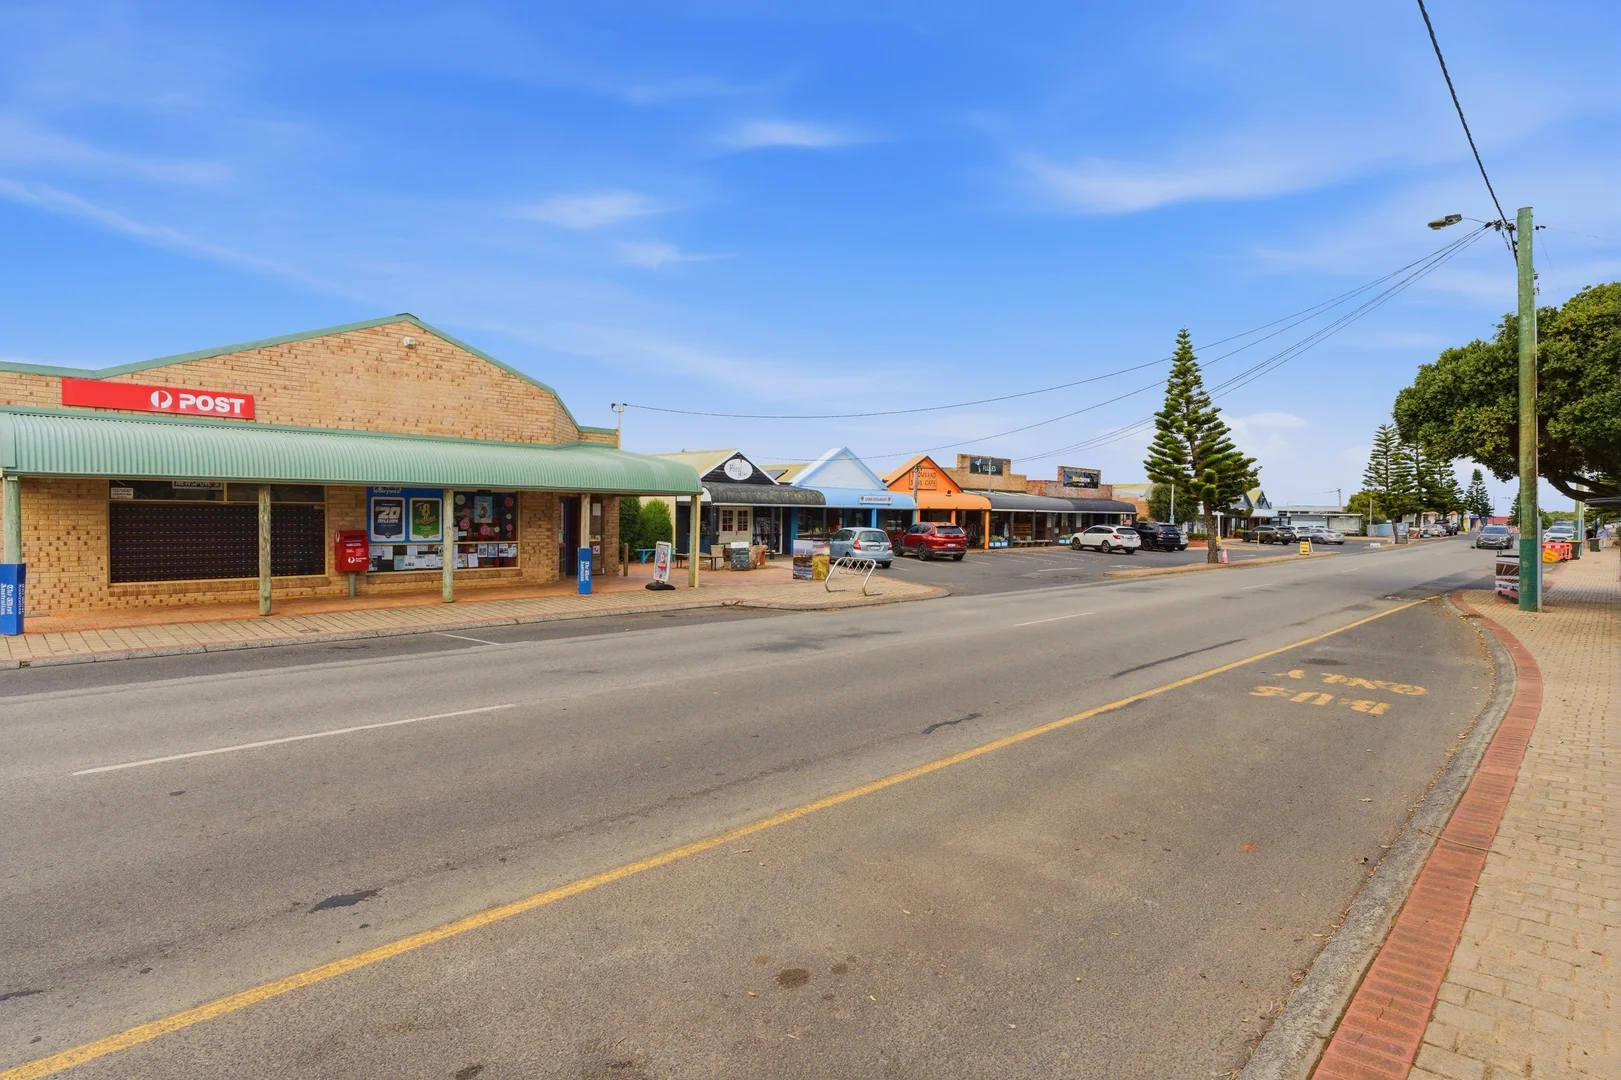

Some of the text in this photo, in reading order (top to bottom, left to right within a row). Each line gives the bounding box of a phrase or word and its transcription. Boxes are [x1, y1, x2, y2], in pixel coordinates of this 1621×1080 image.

[179, 393, 245, 414] POST
[911, 471, 937, 479] TOUSAND
[1248, 685, 1391, 715] BUS
